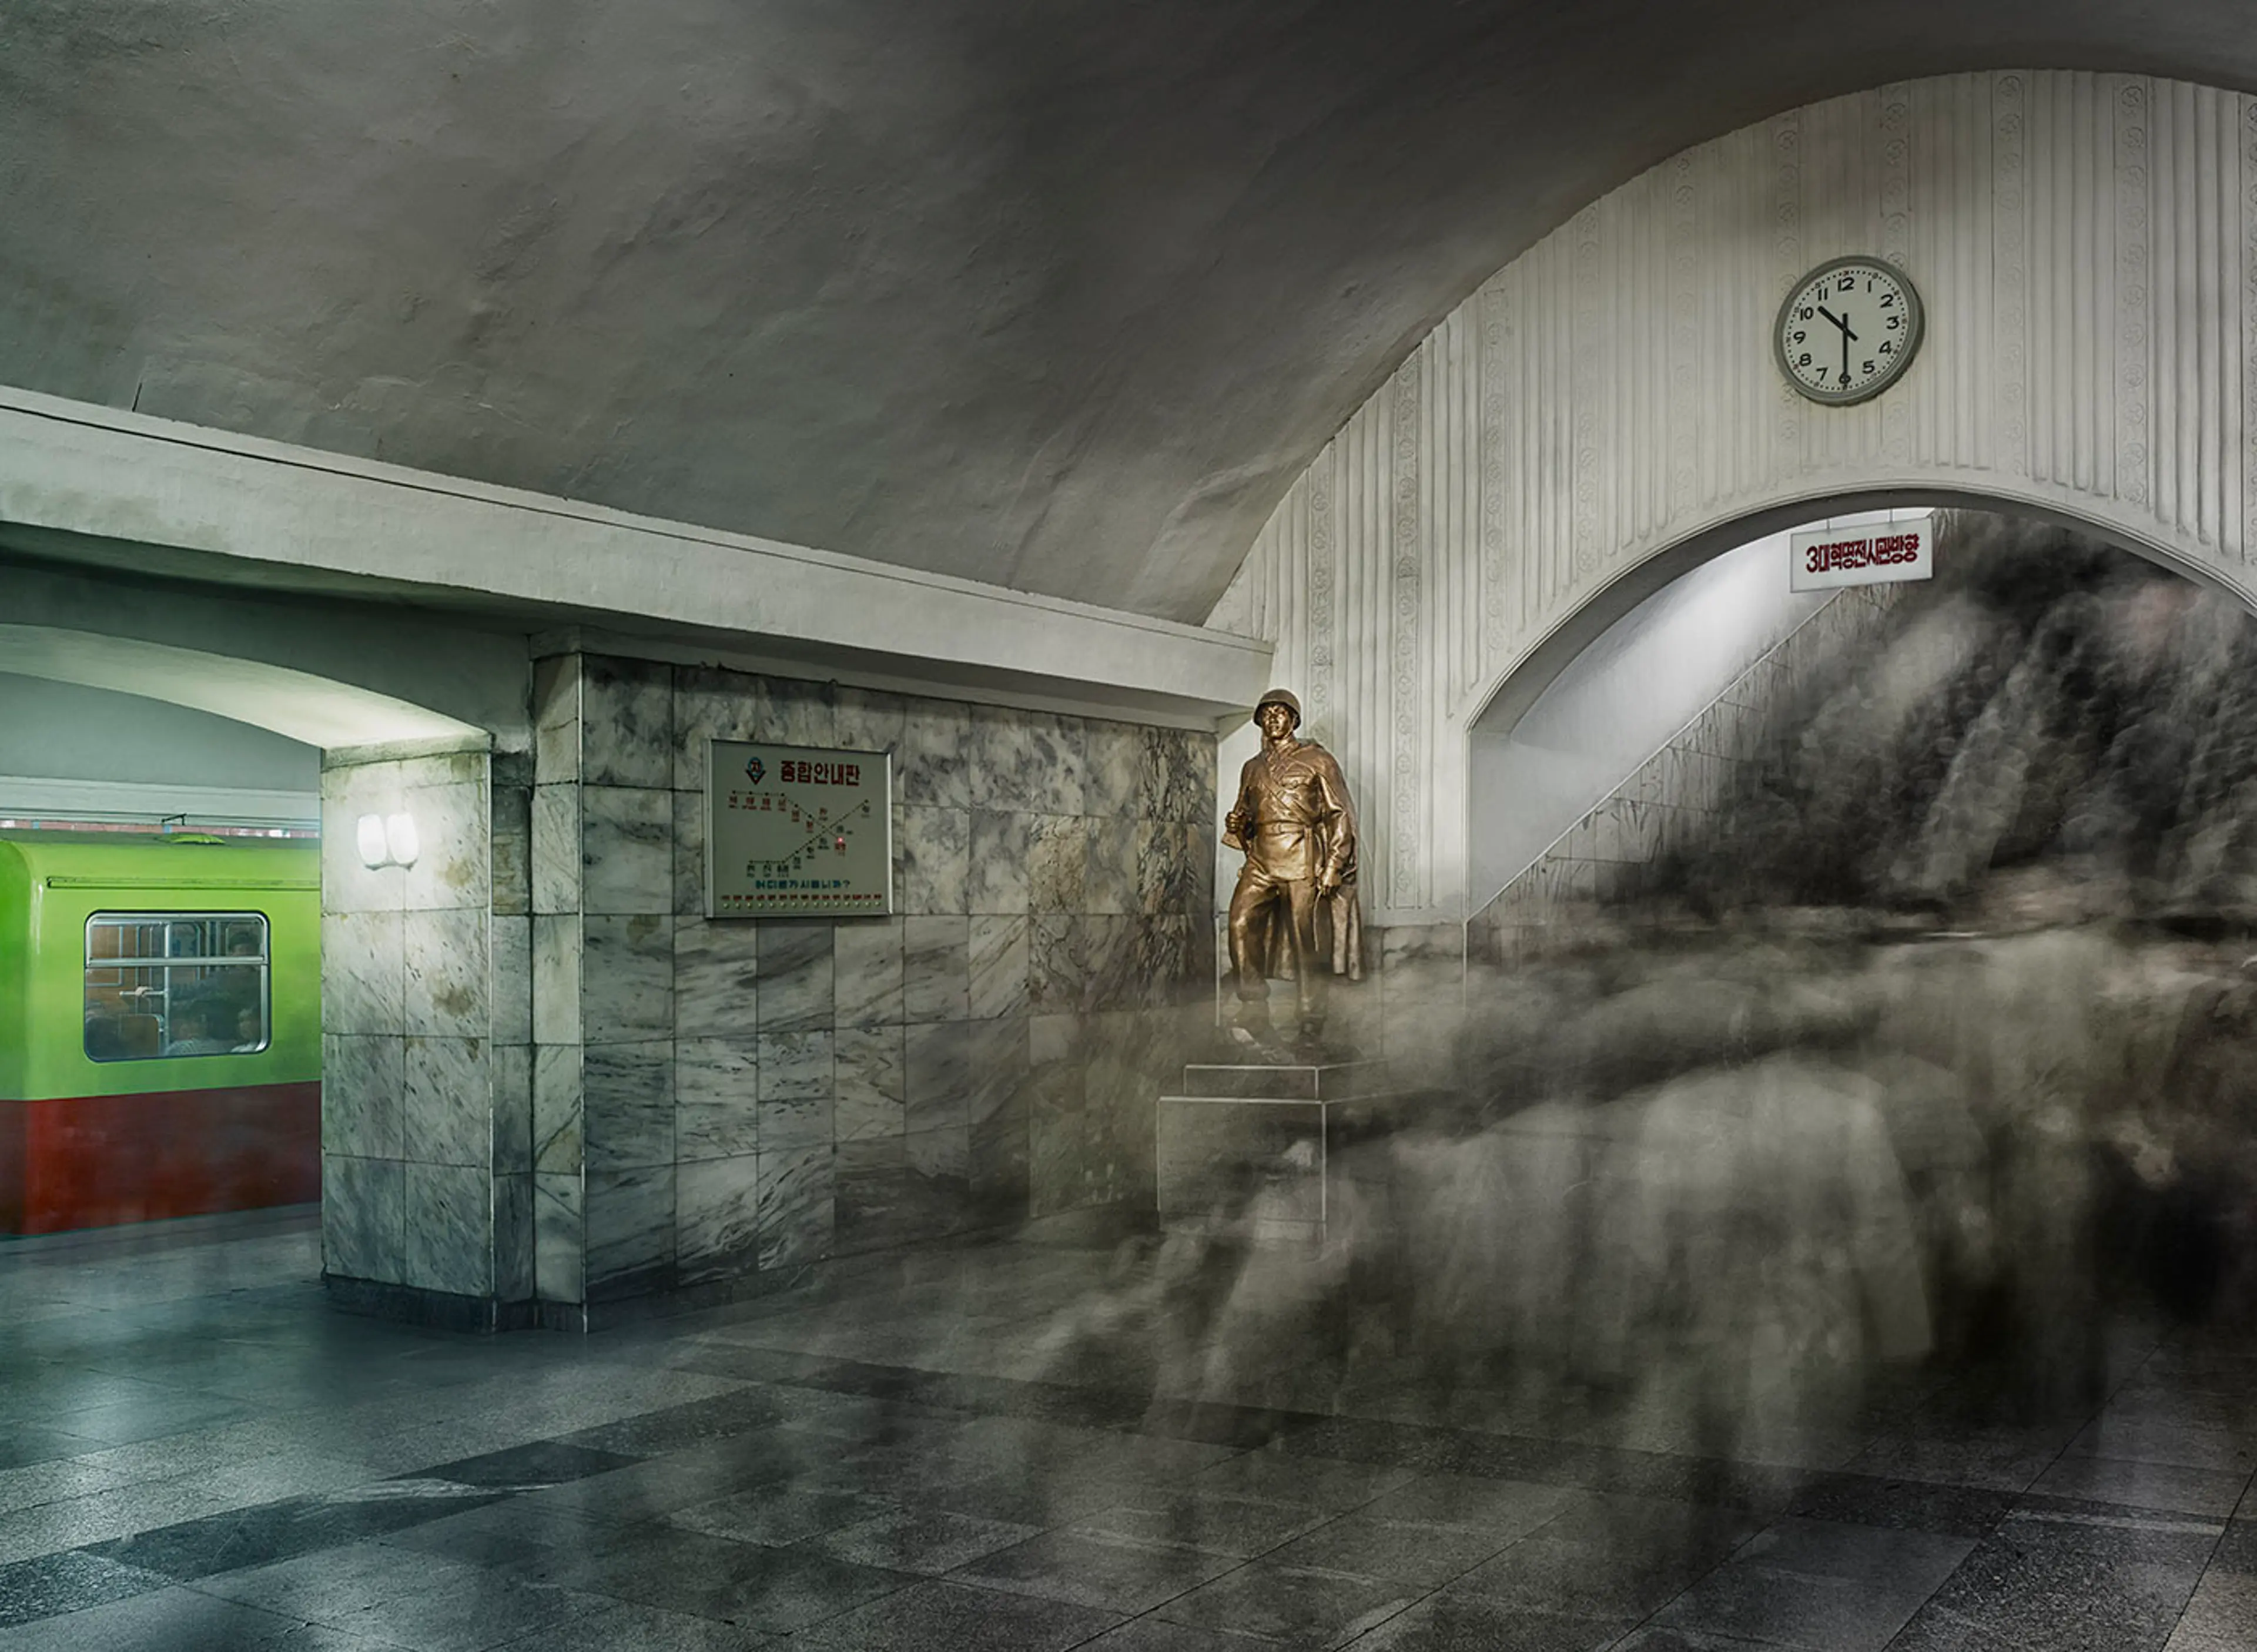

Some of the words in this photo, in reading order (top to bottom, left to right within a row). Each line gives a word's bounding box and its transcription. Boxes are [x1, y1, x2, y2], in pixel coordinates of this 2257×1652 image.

[1837, 277, 1854, 291] 12
[1867, 280, 1871, 293] 1
[1818, 289, 1828, 300] 11
[1880, 294, 1893, 308] 2
[1800, 307, 1813, 320] 10
[1887, 316, 1899, 330] 3
[1794, 331, 1806, 344] 9
[1879, 341, 1891, 354] 4
[1799, 353, 1811, 366] 8
[1816, 367, 1828, 381] 7
[1862, 361, 1874, 374] 5
[781, 760, 860, 786] 종합안내판
